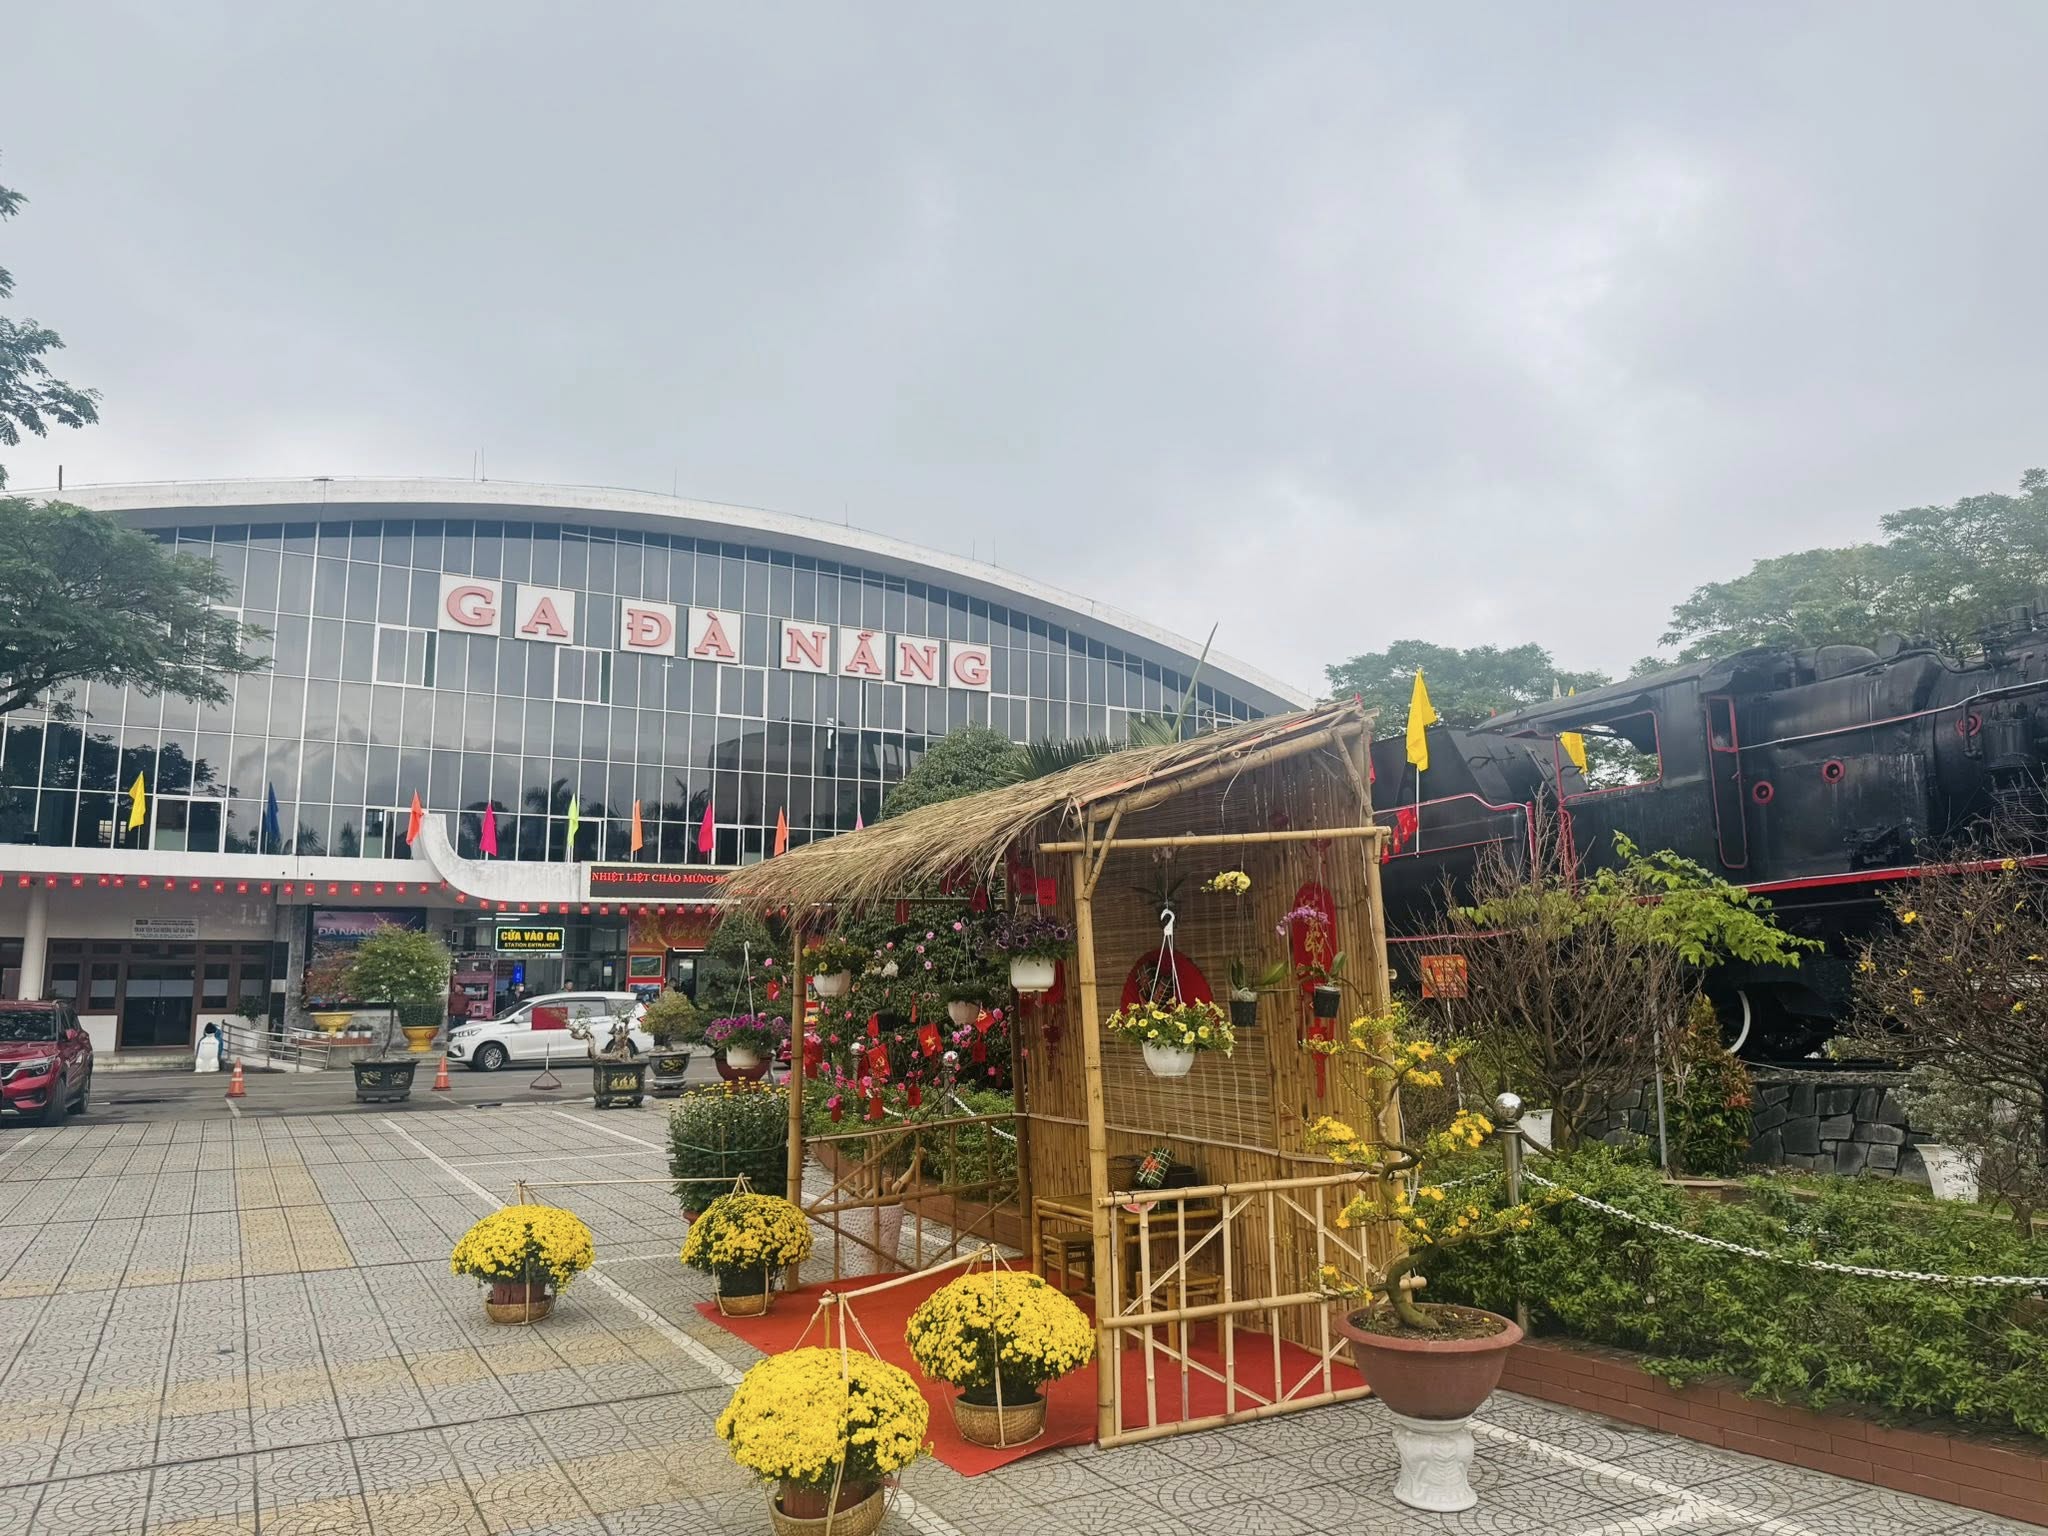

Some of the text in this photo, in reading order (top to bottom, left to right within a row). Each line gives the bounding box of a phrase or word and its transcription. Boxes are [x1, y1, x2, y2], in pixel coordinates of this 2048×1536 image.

[446, 585, 989, 685] GA ĐÀ NẴNG
[591, 871, 624, 882] NHIỆT
[626, 872, 650, 883] LIỆT
[501, 929, 560, 941] CỬA VÀO GA
